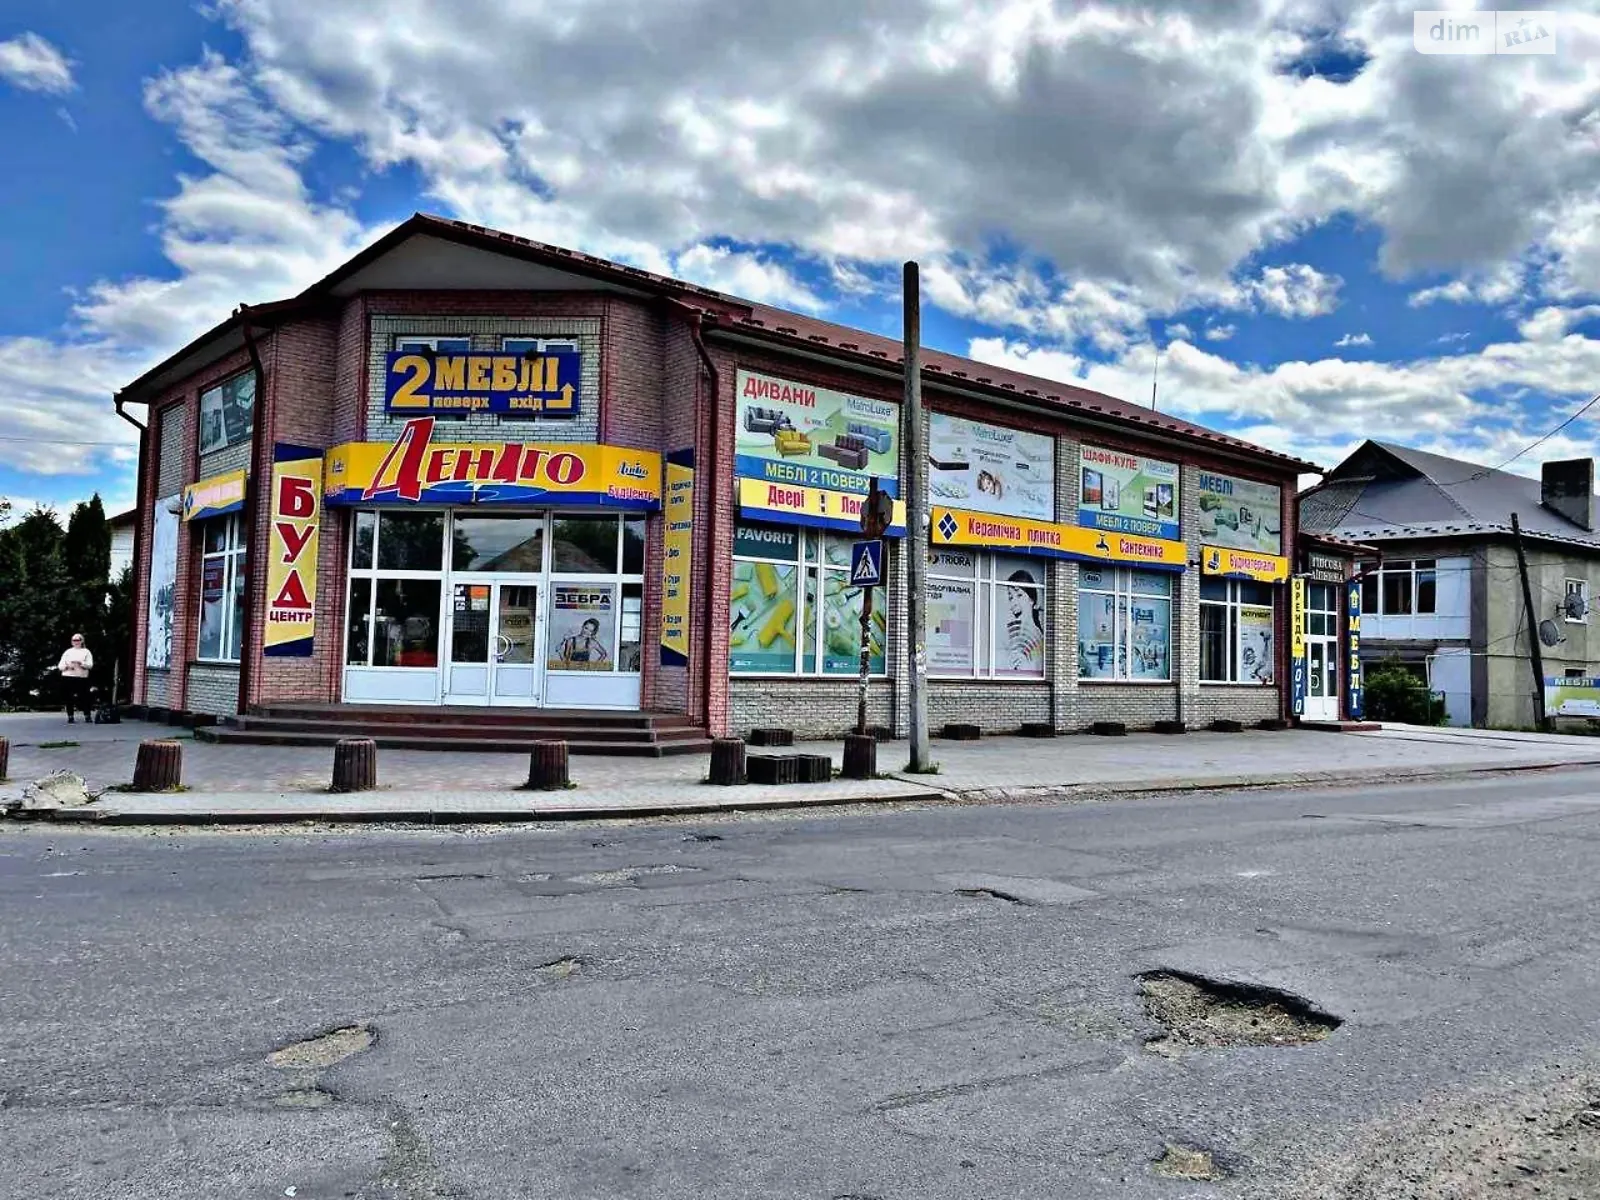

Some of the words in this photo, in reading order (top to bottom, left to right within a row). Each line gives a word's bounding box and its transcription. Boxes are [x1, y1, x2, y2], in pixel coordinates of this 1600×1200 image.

[390, 355, 431, 408] 2
[433, 356, 560, 392] МЕБЛІ
[433, 395, 489, 412] поверх
[510, 395, 543, 411] вхід
[743, 378, 816, 408] ДИВАНИ
[766, 463, 808, 481] МЕБЛІ
[811, 471, 818, 483] 2
[822, 472, 871, 491] ПОВЕРХ
[1200, 475, 1233, 496] МЕБЛІ
[768, 485, 805, 508] Двері
[968, 518, 1021, 540] Керамічна
[1028, 529, 1061, 545] плитка
[1096, 514, 1122, 528] МЕБЛІ
[1124, 520, 1129, 530] 2
[1131, 520, 1162, 535] ПОВЕРХ
[272, 476, 316, 610] БУД
[736, 527, 795, 545] FAVORIT
[1120, 538, 1164, 558] Сантехніка
[940, 554, 971, 567] TRIORA
[555, 593, 611, 604] ЗЕБРА
[269, 611, 313, 623] ЦЕНТР
[1294, 581, 1303, 645] ОРЕНДА
[1349, 616, 1361, 709] МЕБЛІ
[1554, 678, 1594, 687] МЕБЛІ
